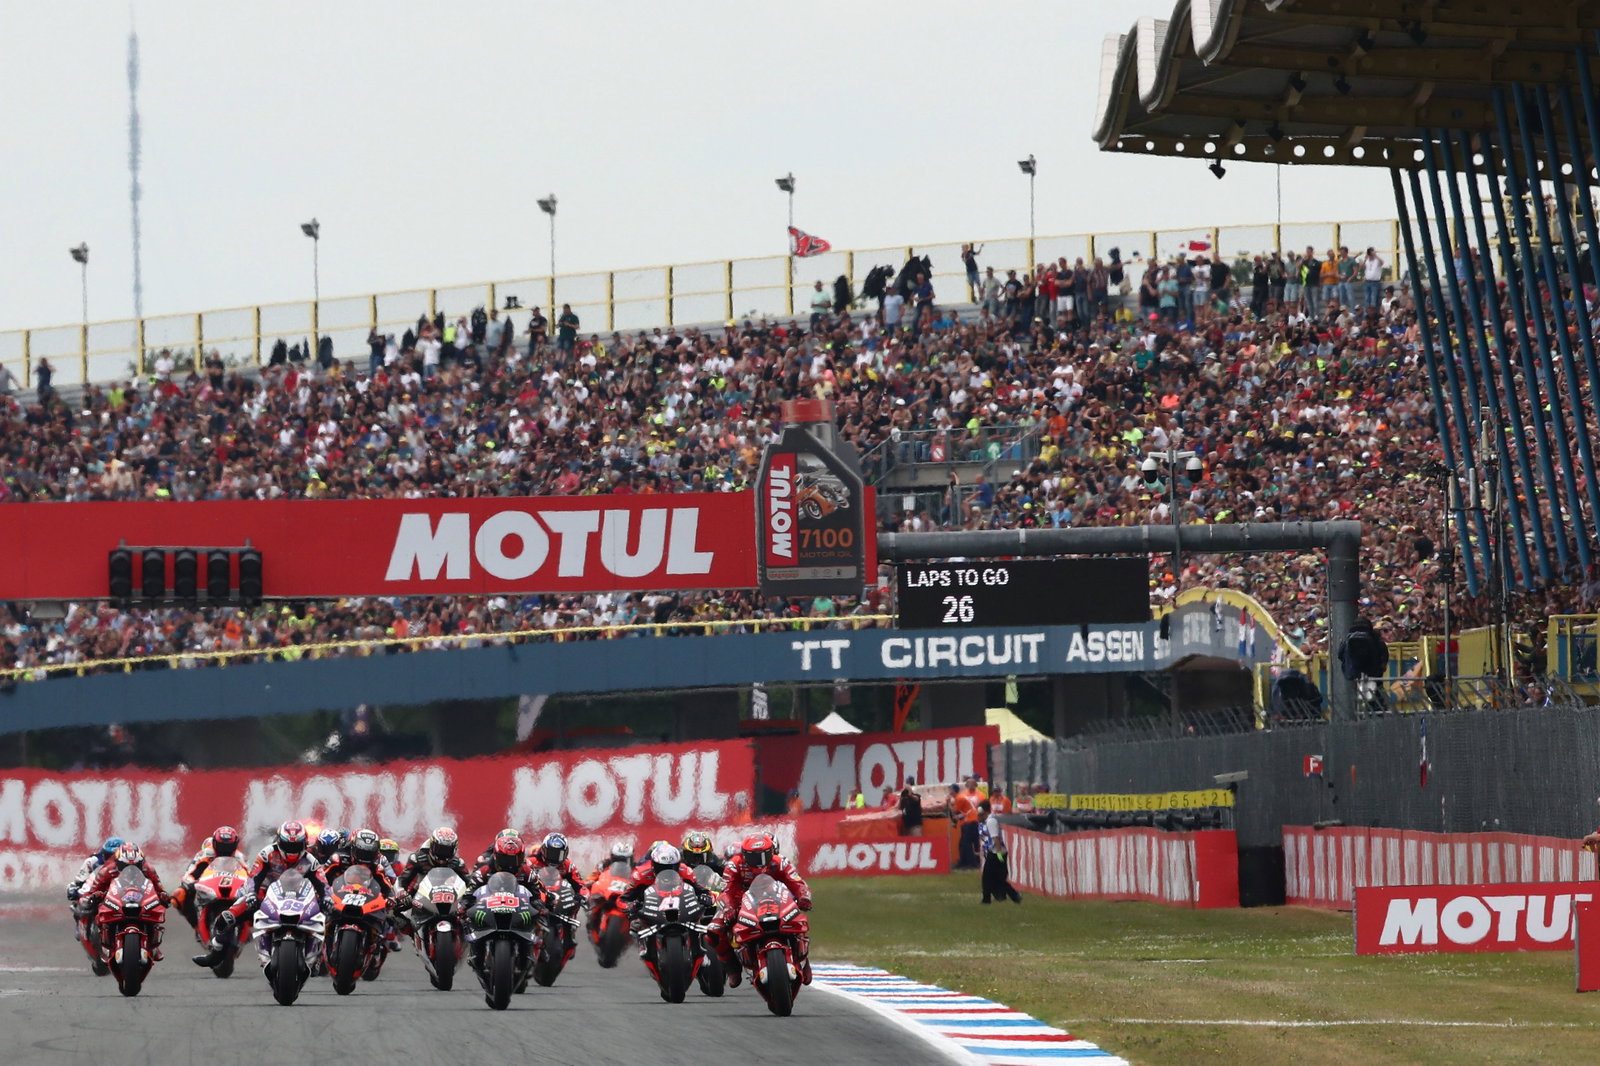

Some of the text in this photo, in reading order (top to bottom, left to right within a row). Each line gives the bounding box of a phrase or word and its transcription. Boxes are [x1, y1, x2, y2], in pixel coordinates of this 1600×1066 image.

[770, 465, 792, 558] MOTUL
[800, 528, 853, 548] 7100
[385, 507, 714, 581] MOTUL
[907, 568, 1009, 587] LAPS TO GO
[942, 596, 974, 622] 26
[792, 639, 850, 670] TT
[881, 633, 1045, 668] CIRCUIT
[1066, 630, 1144, 662] ASSEN
[508, 749, 728, 832] MOTUL
[799, 736, 974, 810] MOTUL
[243, 766, 457, 845] MOTUL
[809, 842, 937, 873] MOTUL
